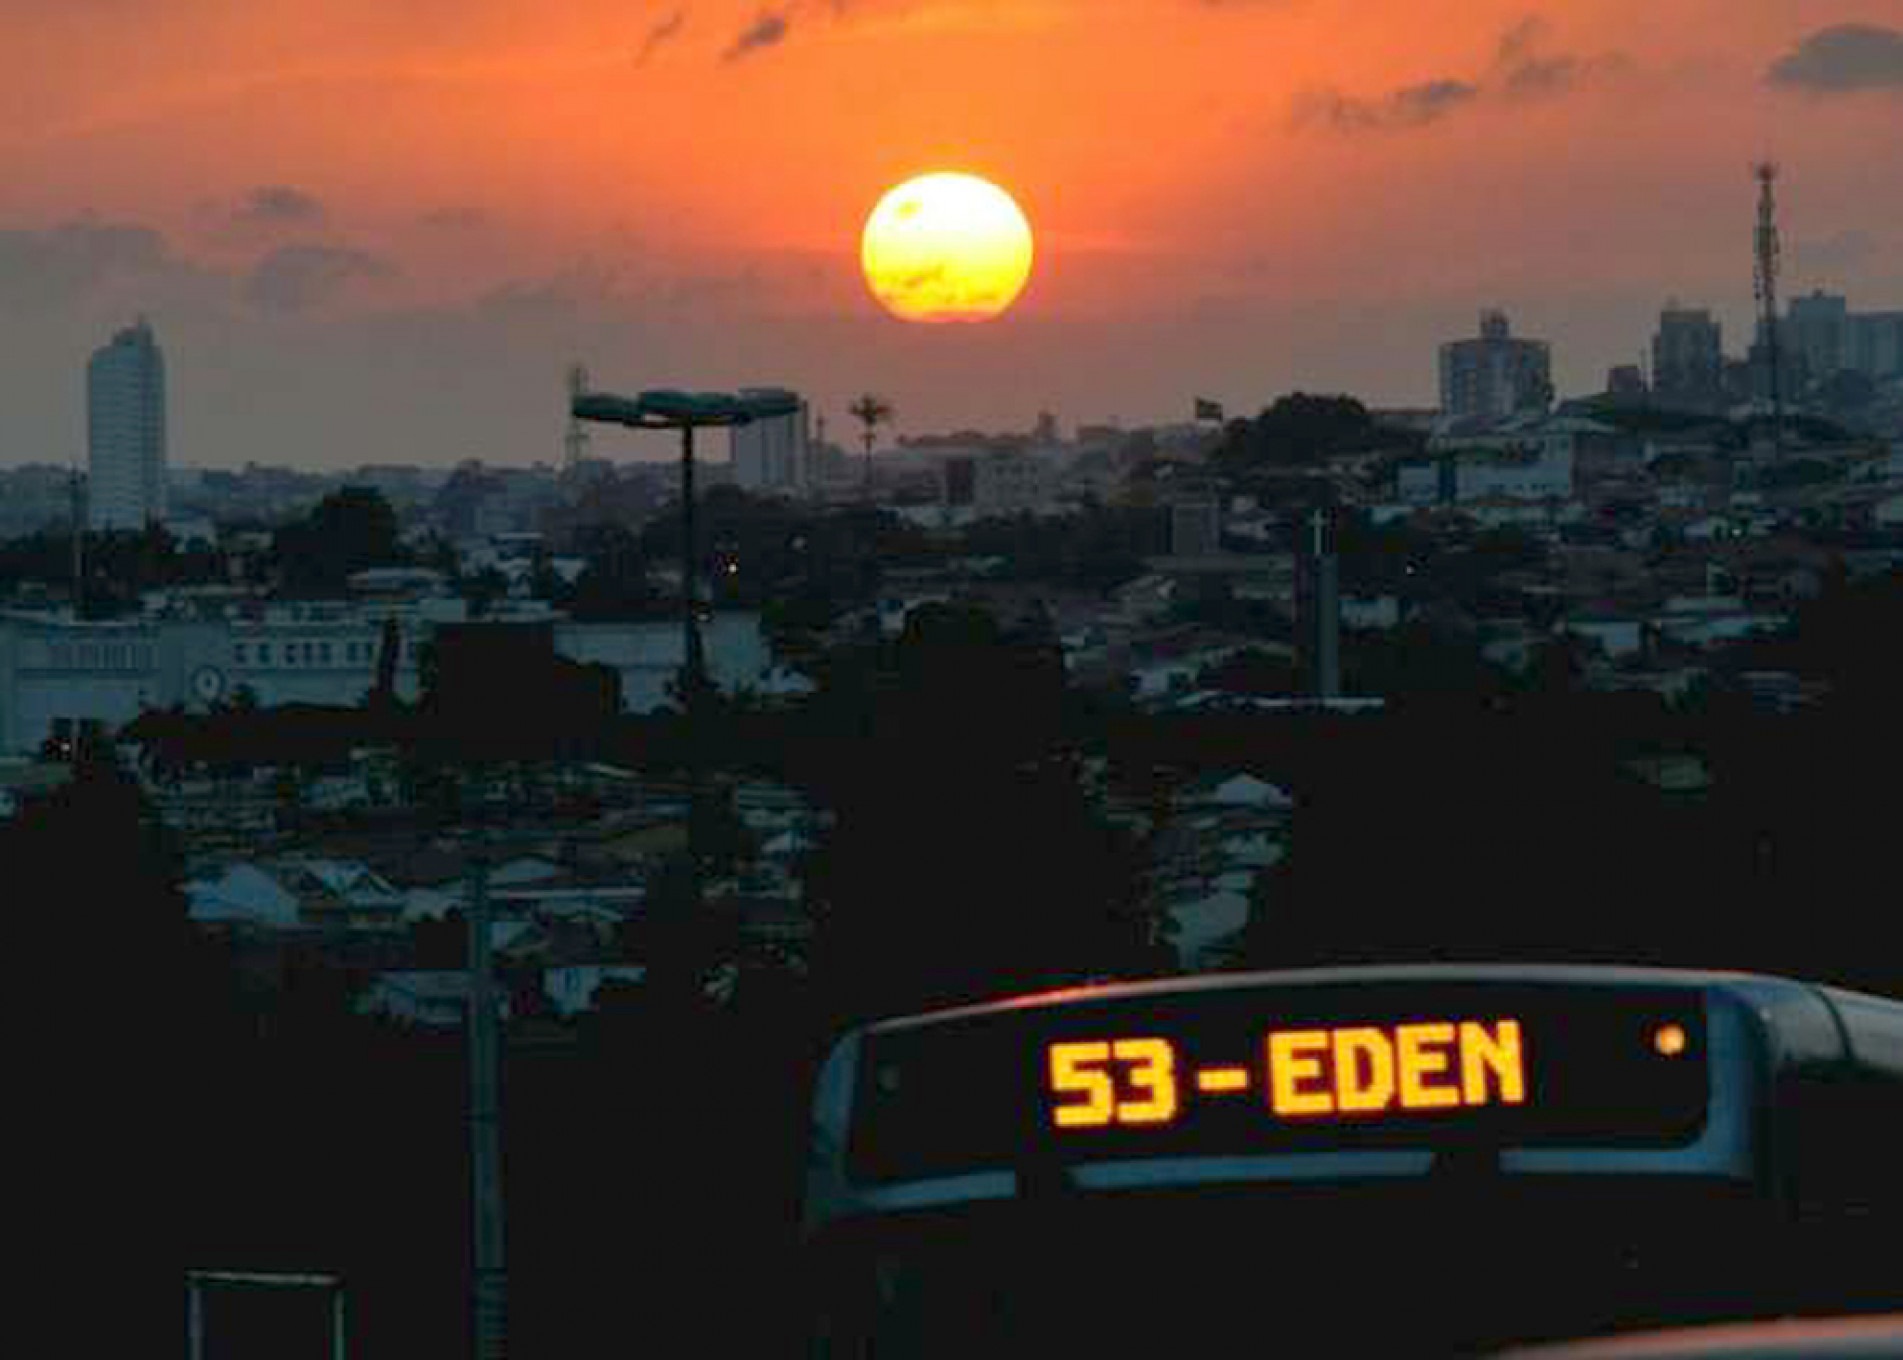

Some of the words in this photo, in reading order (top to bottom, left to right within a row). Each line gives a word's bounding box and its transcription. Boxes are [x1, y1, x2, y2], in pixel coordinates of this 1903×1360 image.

[1049, 1038, 1176, 1126] 53
[1197, 1067, 1247, 1091] -
[1268, 1019, 1523, 1115] EDEN
